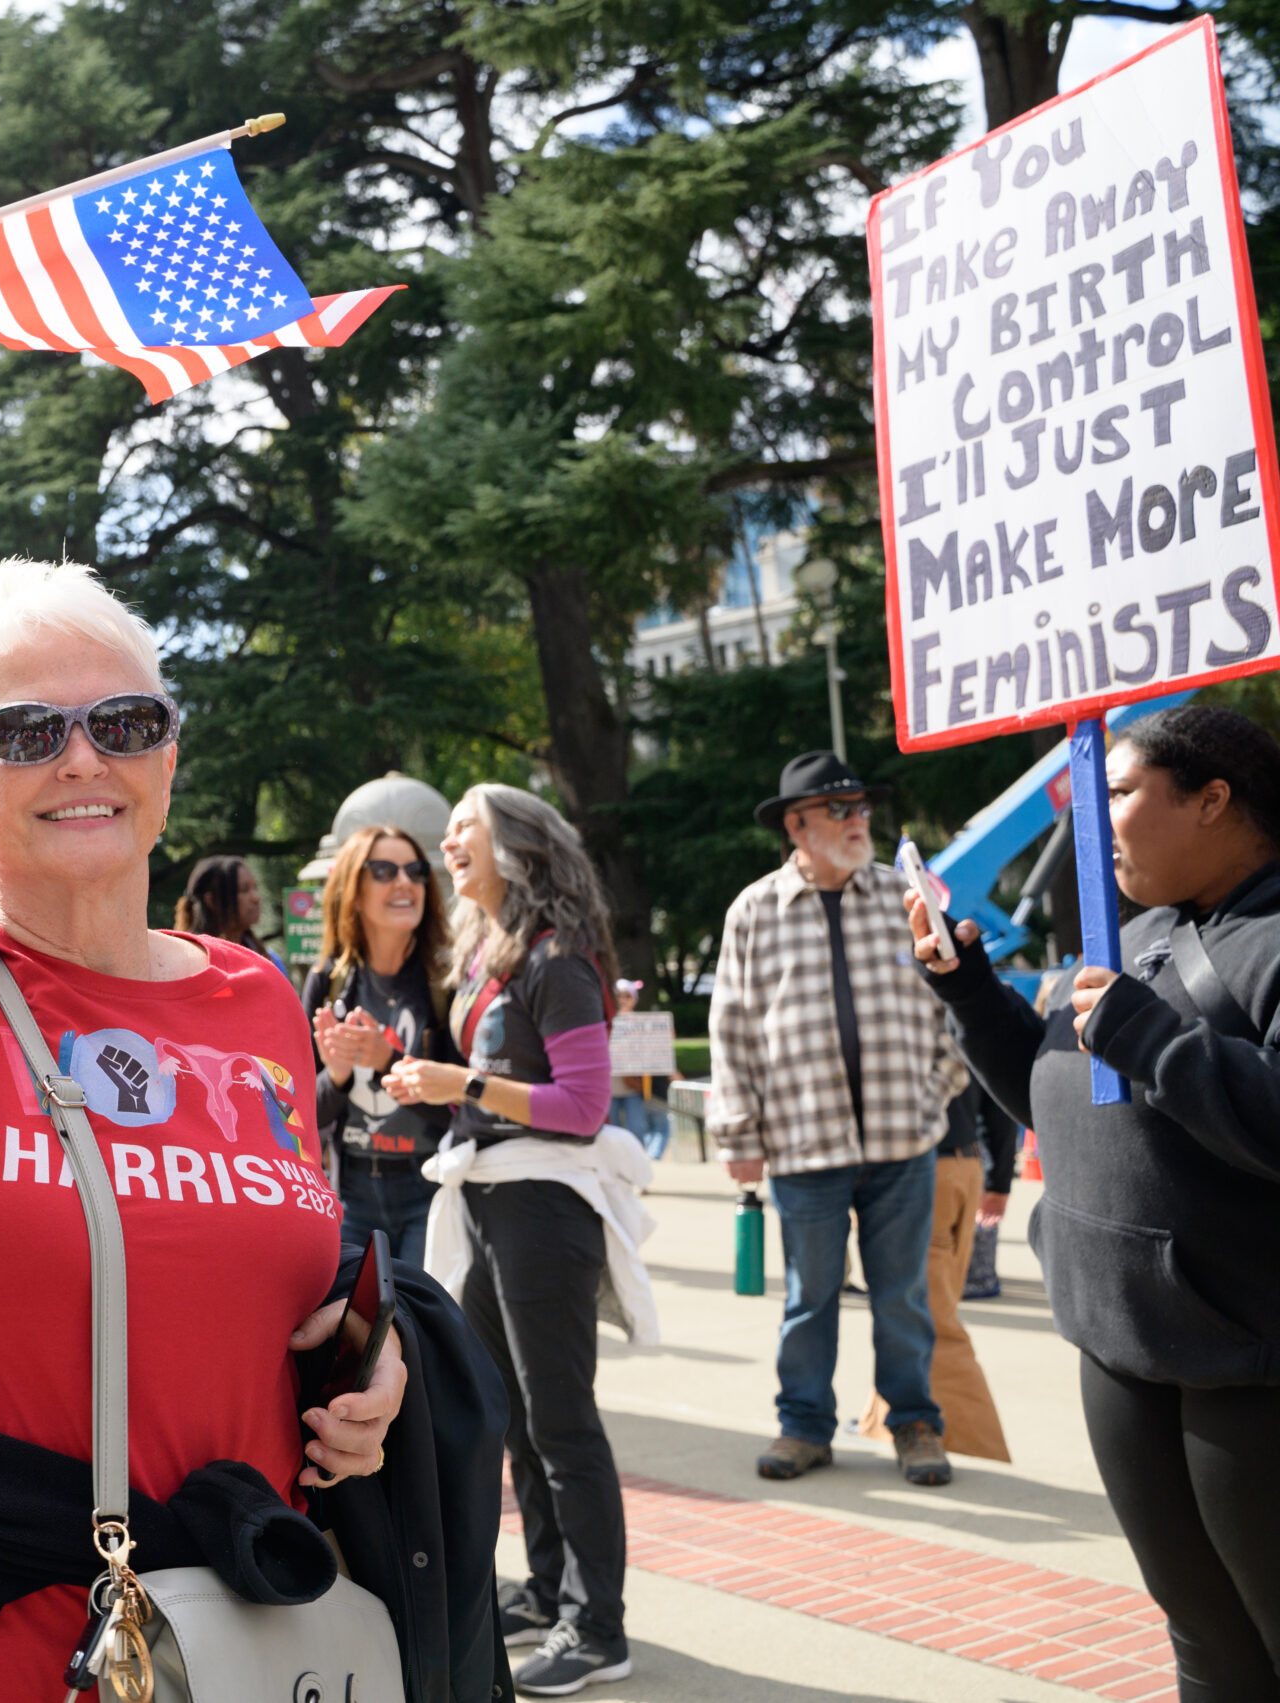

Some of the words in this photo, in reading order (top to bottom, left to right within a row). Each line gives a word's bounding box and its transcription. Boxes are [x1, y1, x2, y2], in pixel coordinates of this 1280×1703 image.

[1045, 140, 1198, 257] AWAY
[897, 316, 959, 394] MY
[990, 216, 1210, 355] BIRTH
[1004, 379, 1186, 490] JUST
[291, 1184, 337, 1219] 202
